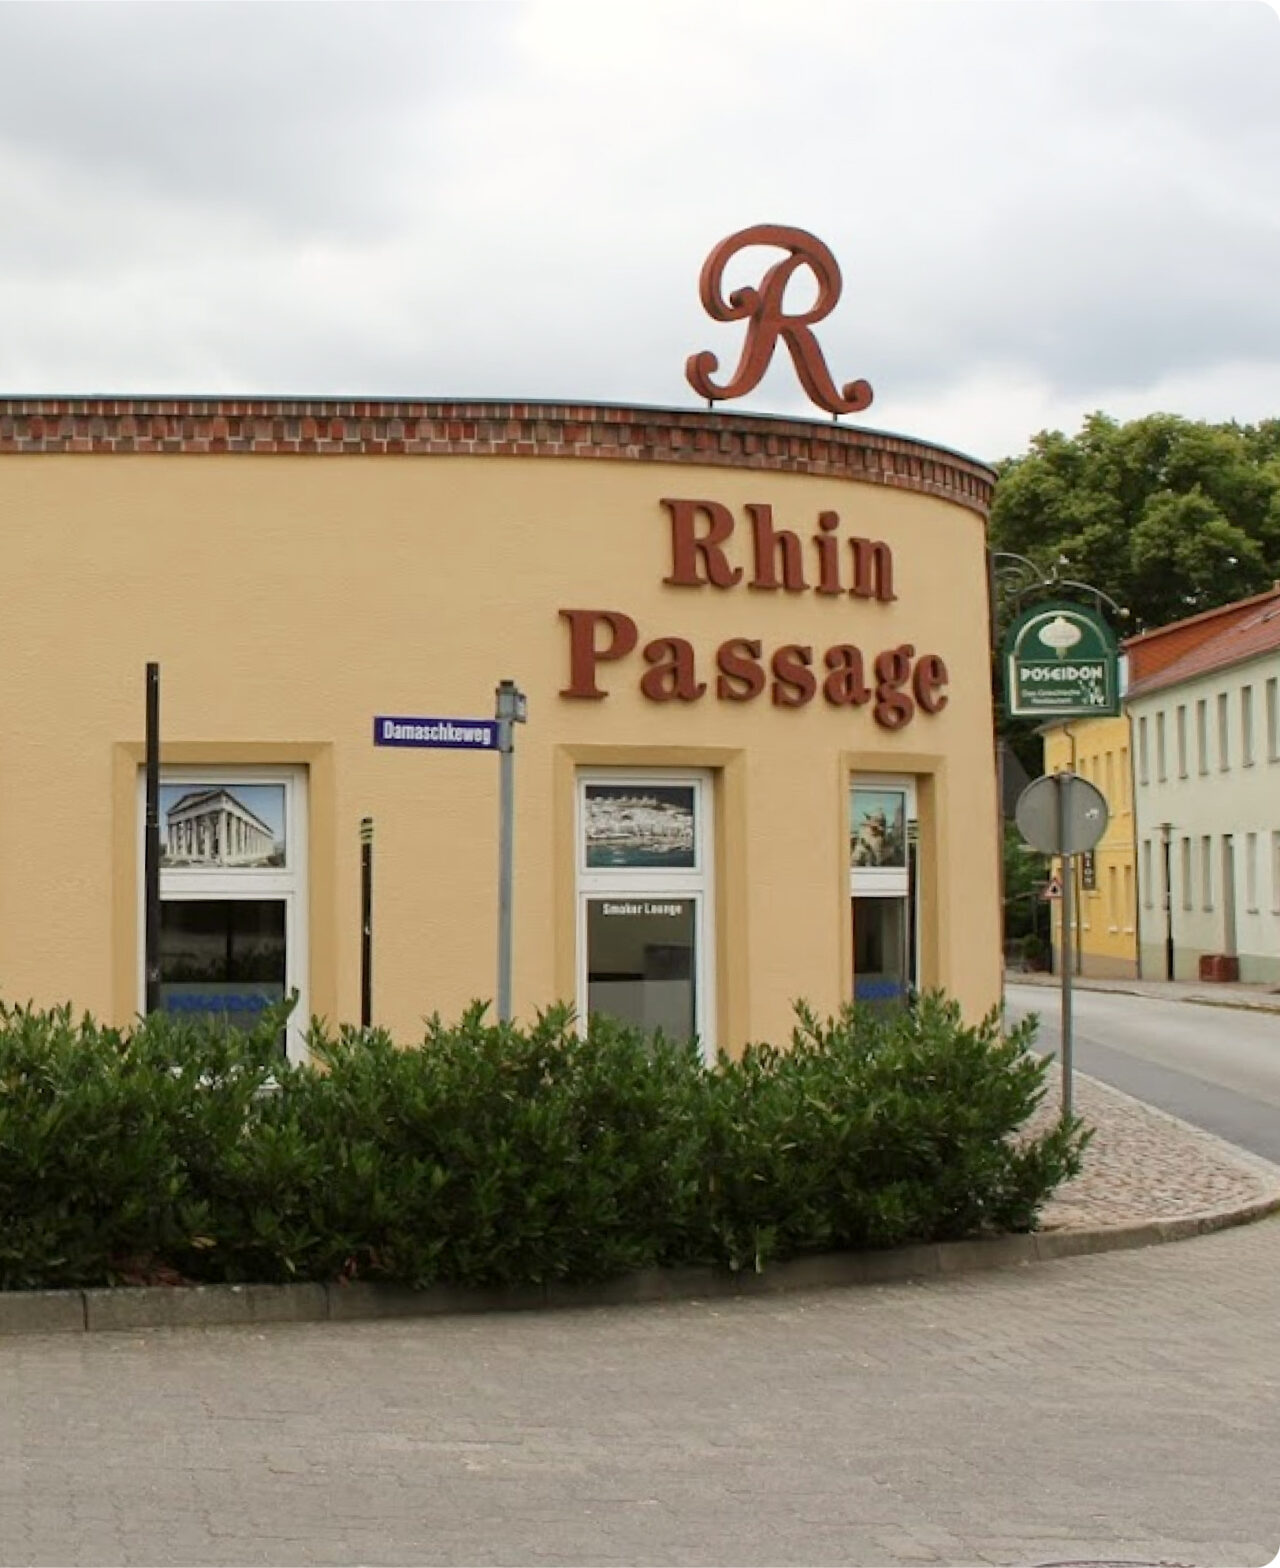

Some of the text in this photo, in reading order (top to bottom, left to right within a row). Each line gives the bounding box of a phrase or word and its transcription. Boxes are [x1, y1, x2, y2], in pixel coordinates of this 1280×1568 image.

[685, 223, 874, 415] R
[659, 498, 899, 601] Rhin
[558, 609, 949, 729] Passage
[1020, 665, 1103, 681] POSEIDON
[383, 720, 491, 745] Damaschkeweg
[602, 902, 683, 916] Smoker Lounge
